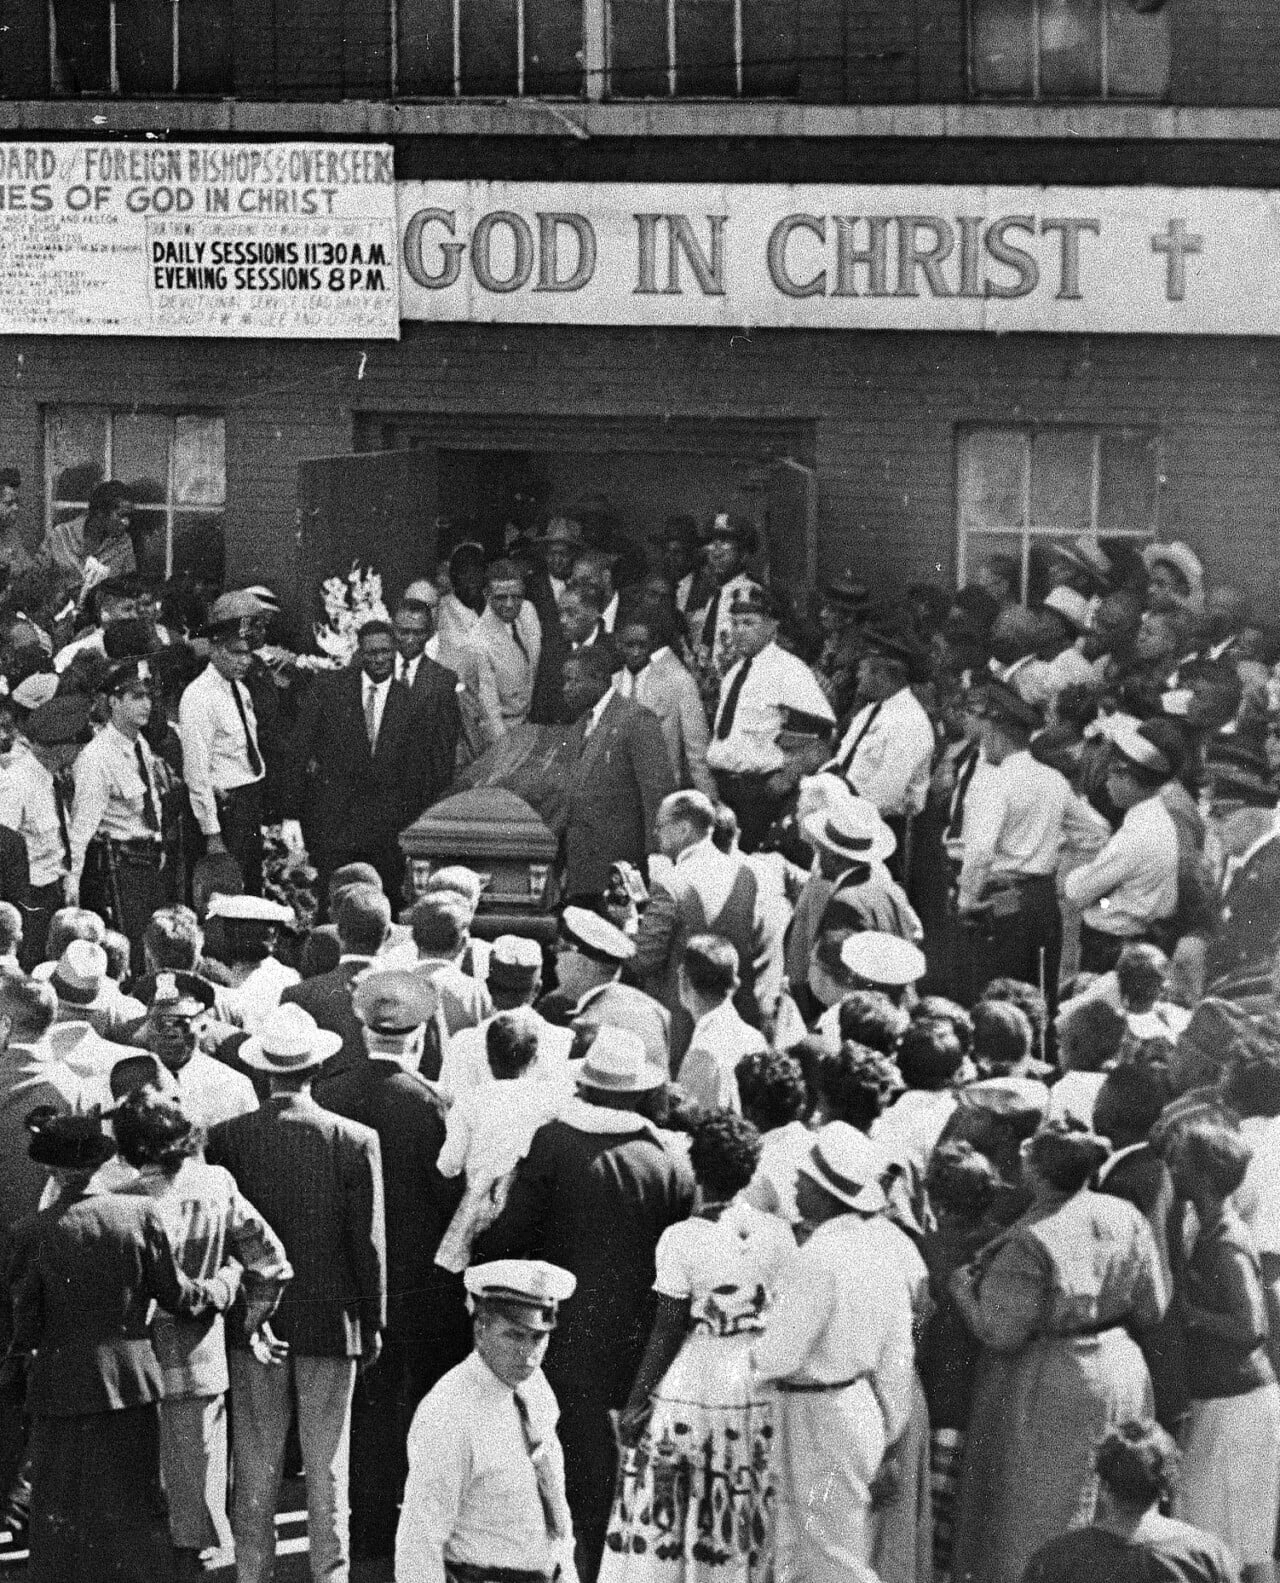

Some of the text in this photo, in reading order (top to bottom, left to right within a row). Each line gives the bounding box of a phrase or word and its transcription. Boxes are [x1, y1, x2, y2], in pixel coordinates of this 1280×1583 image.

[85, 148, 182, 182] FOREIGN
[188, 149, 273, 183] BISHOPS
[65, 184, 112, 213] OF
[125, 184, 195, 214] GOD
[205, 186, 230, 213] IN
[237, 187, 339, 215] CHRIST
[153, 241, 206, 265] DAILY
[211, 241, 299, 265] SESSIONS
[402, 206, 1101, 299] GOD IN CHRIST
[154, 267, 228, 290] EVENING
[234, 267, 322, 291] SESSIONS
[328, 267, 345, 292] 8
